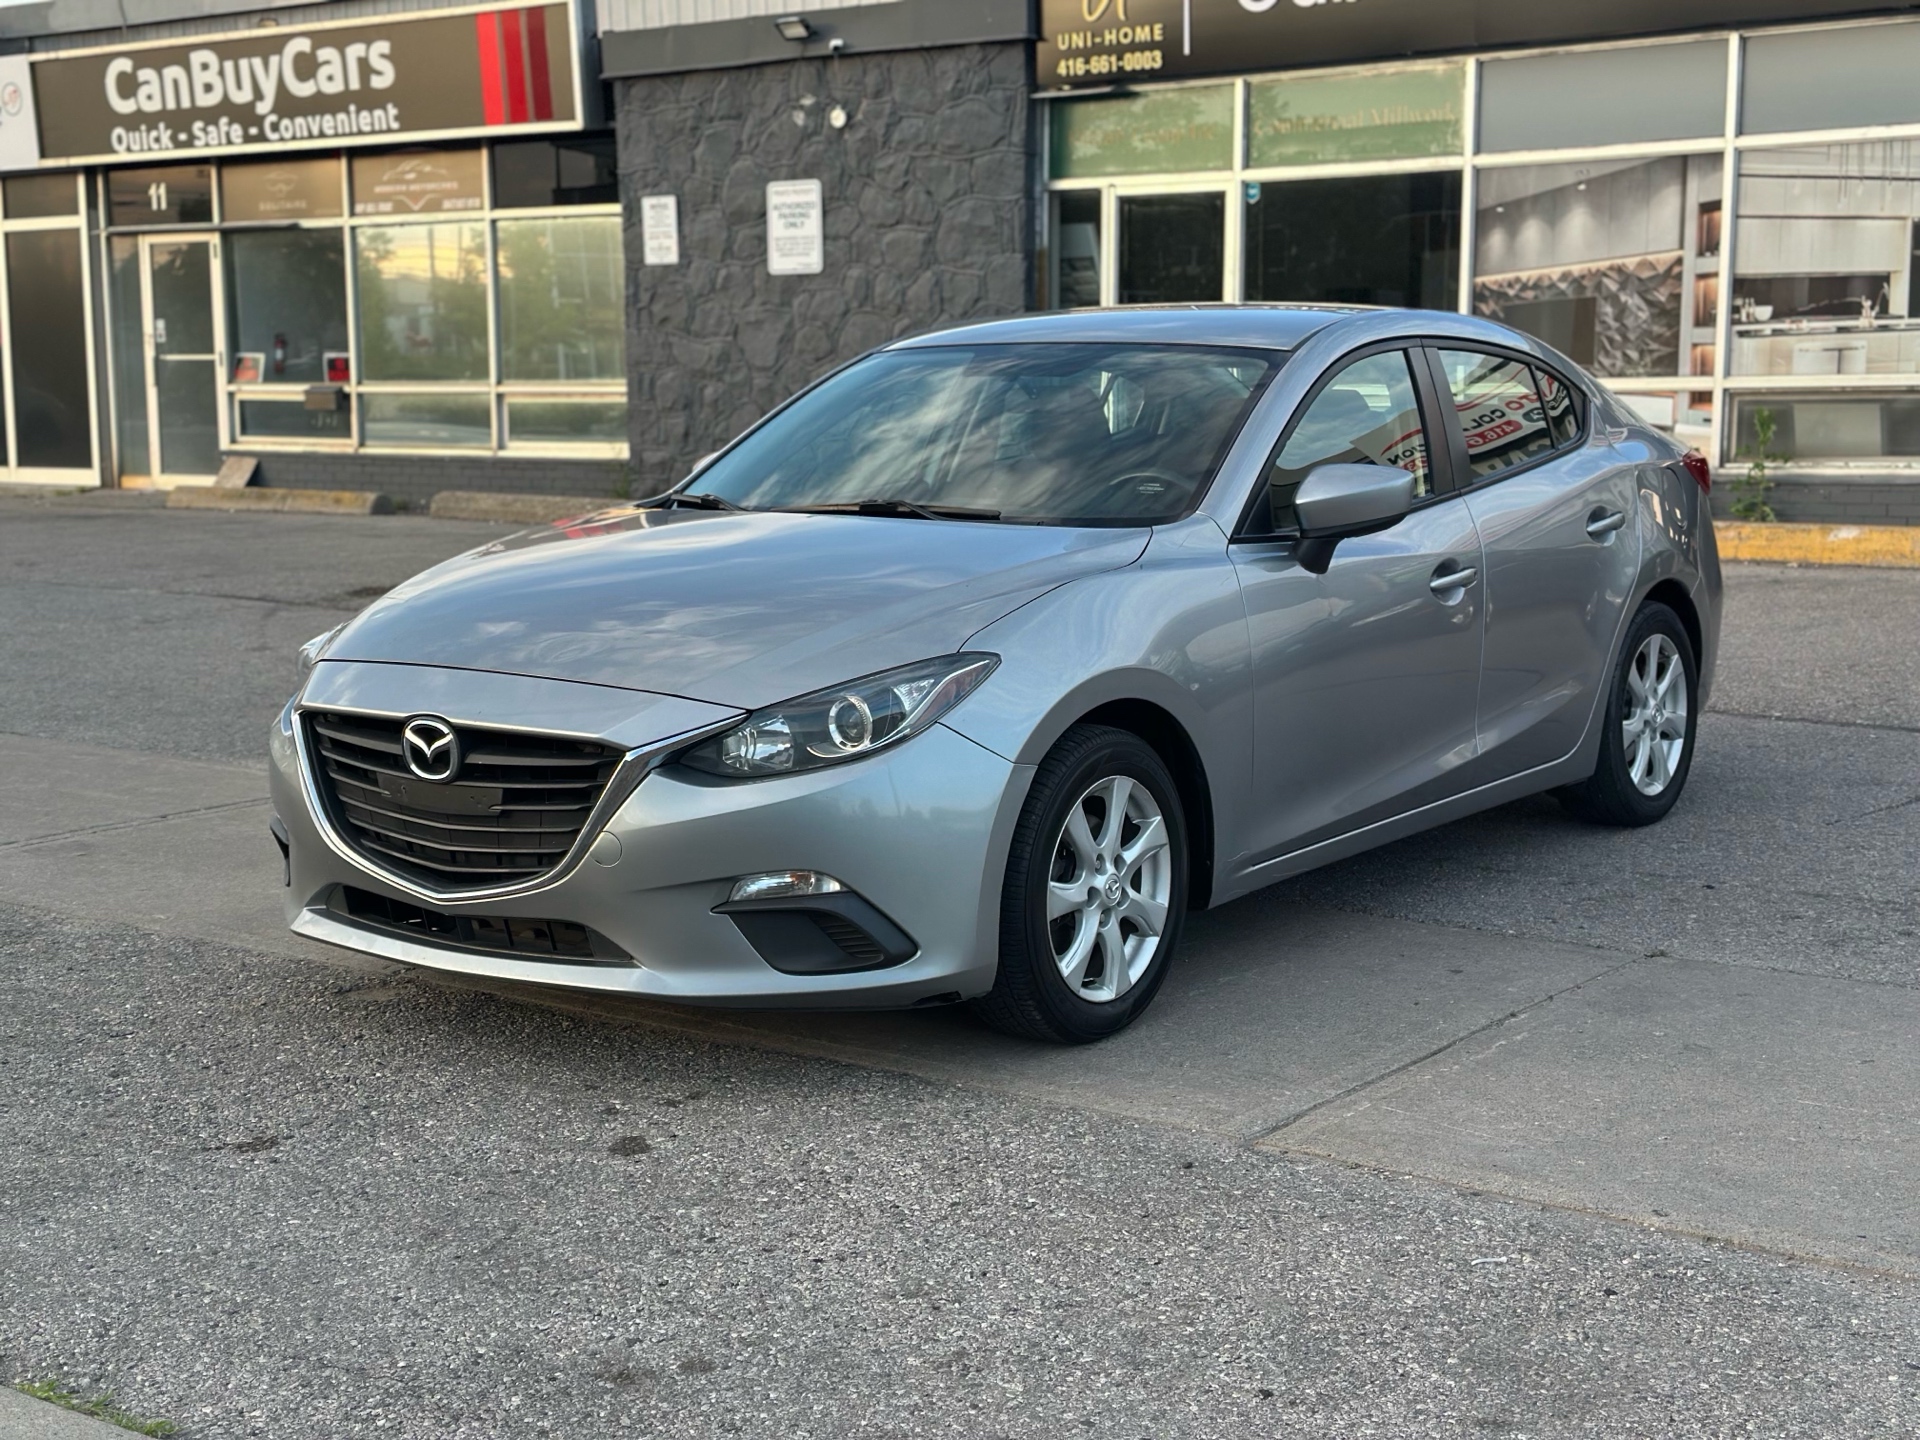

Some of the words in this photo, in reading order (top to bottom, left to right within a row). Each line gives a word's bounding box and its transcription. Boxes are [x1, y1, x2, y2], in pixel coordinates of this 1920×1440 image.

[1057, 23, 1164, 51] UNI-HOME
[104, 36, 396, 116] CanBuyCars
[1056, 50, 1162, 77] 416-661-0003
[111, 122, 173, 154] Quick
[192, 116, 243, 147] Safe
[263, 103, 399, 141] Convenient
[148, 182, 167, 211] 11
